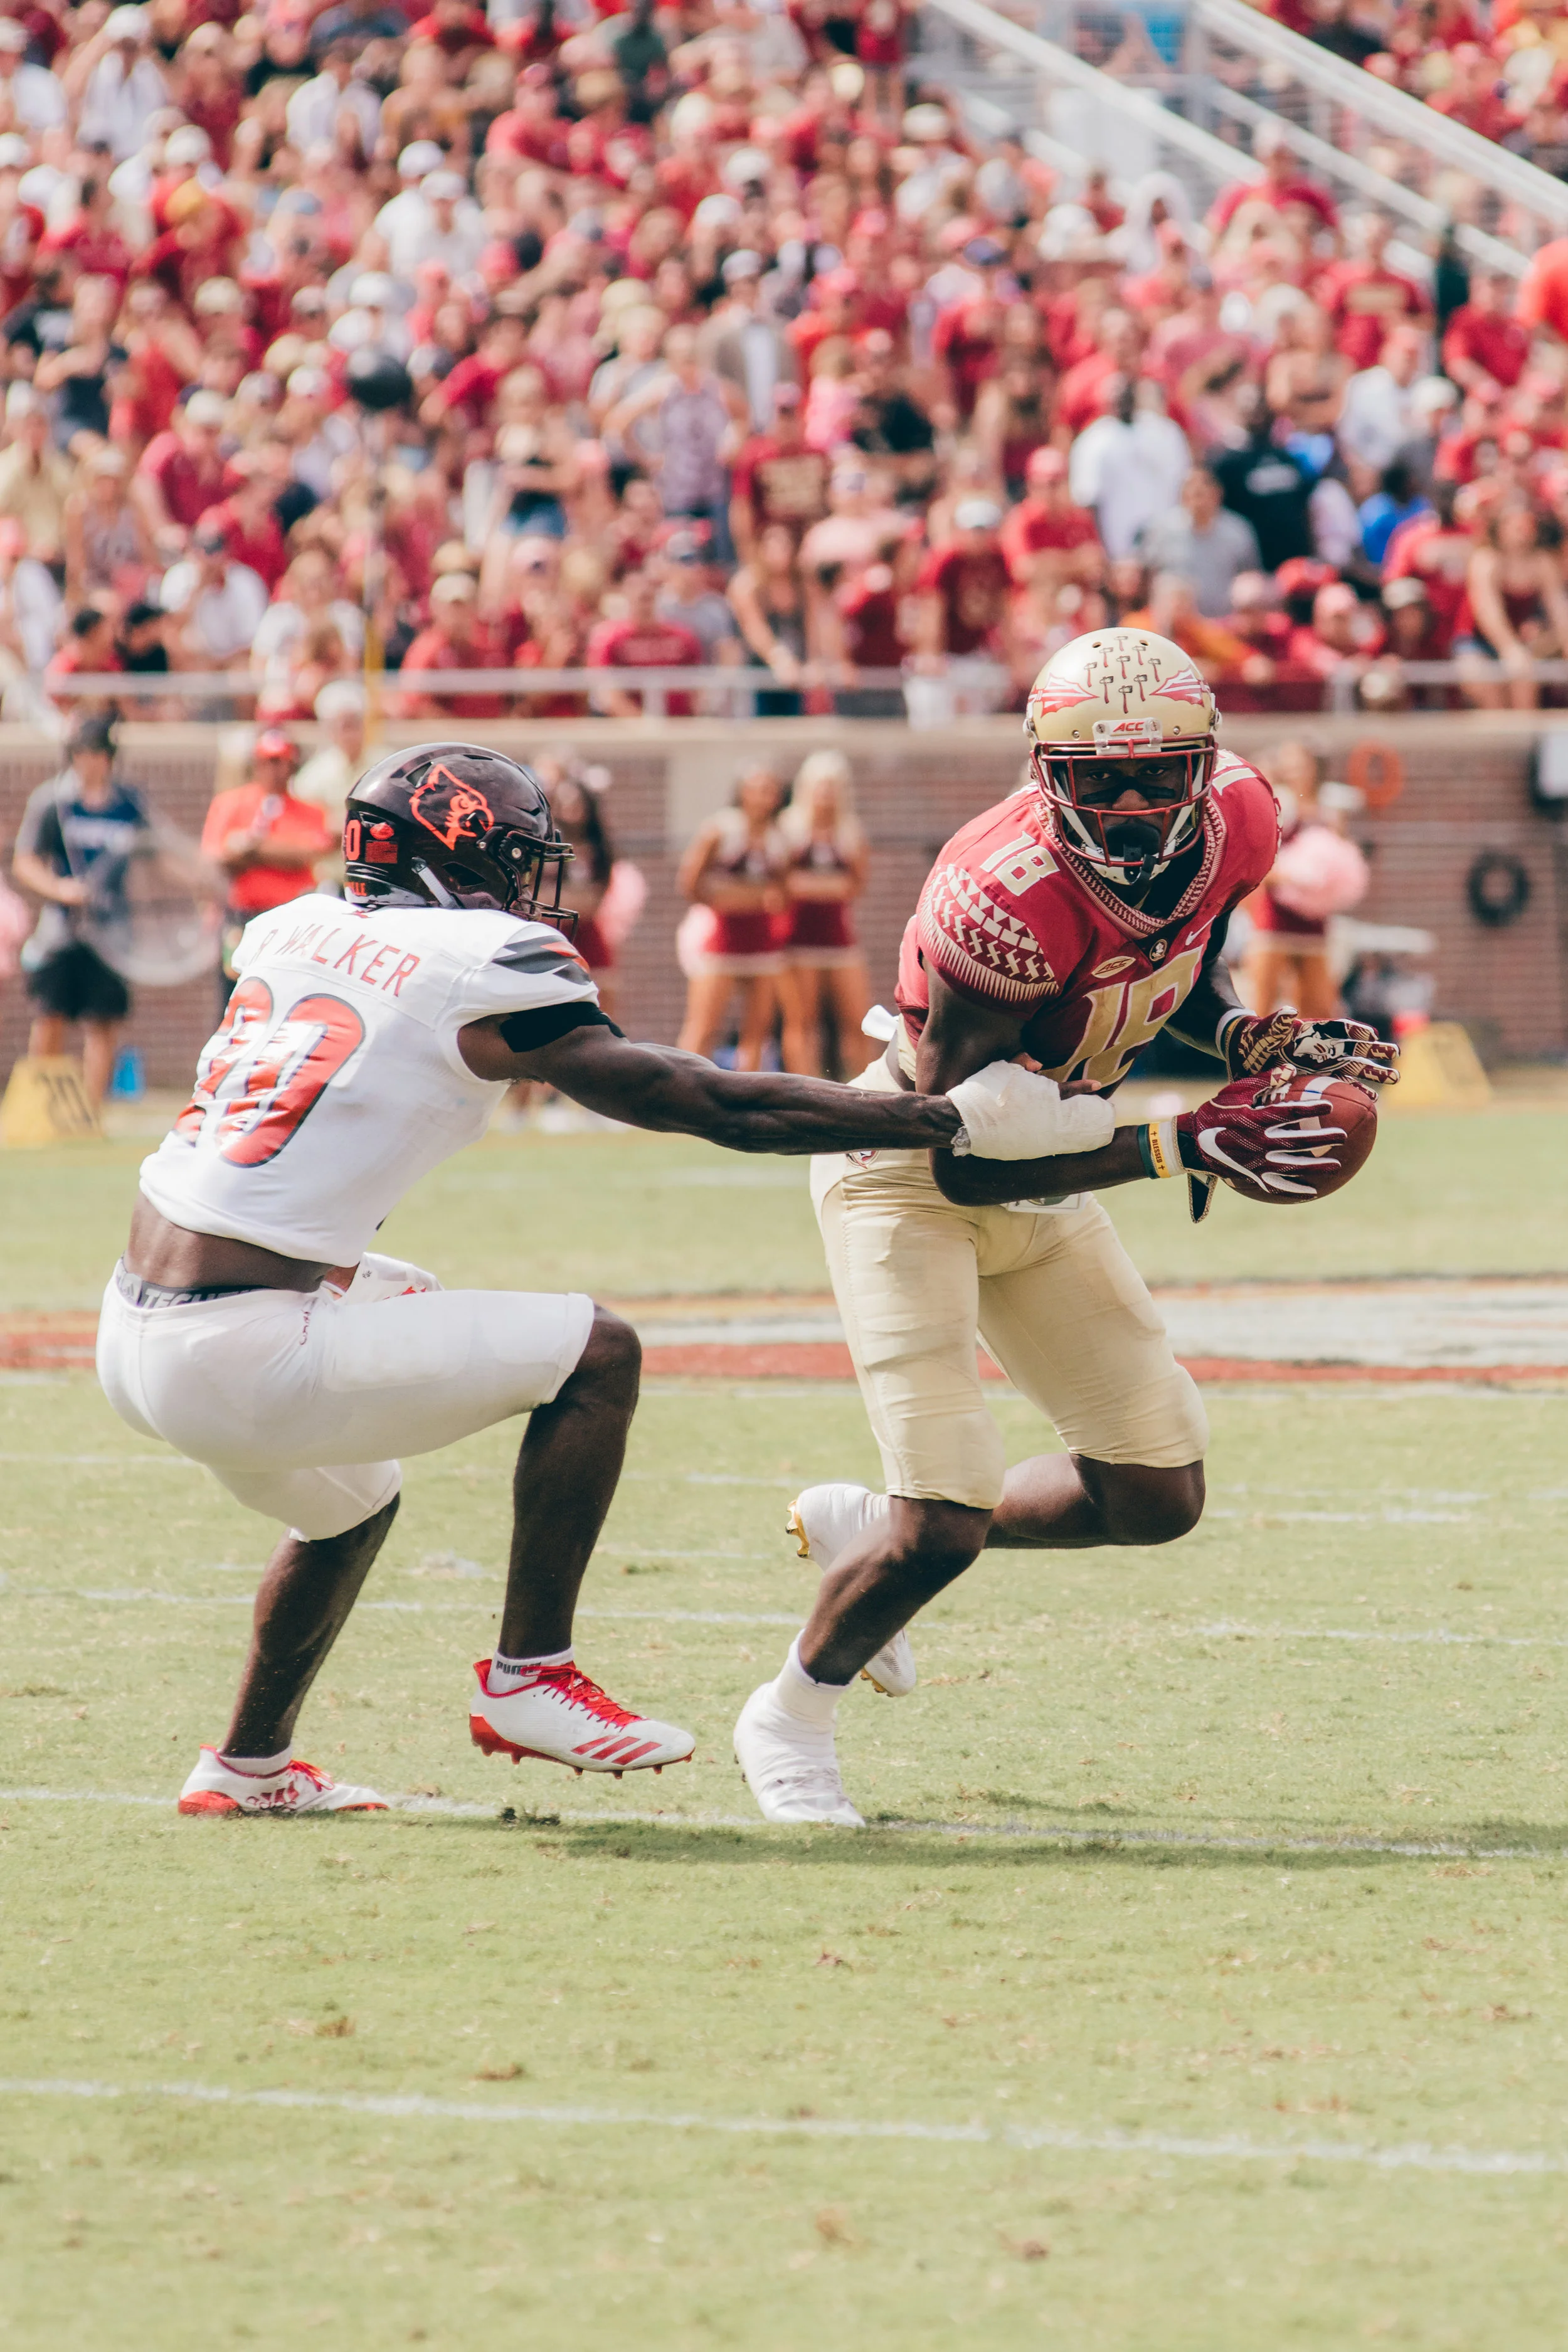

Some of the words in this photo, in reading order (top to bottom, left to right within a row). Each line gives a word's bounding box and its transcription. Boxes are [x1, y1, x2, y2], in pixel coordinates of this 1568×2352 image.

[1113, 721, 1145, 733] ACC
[978, 830, 1061, 897] 18
[274, 923, 421, 997] WALKER
[1098, 959, 1130, 972] ACC
[1152, 1139, 1163, 1163] BLESSED
[495, 1661, 527, 1675] PUM
